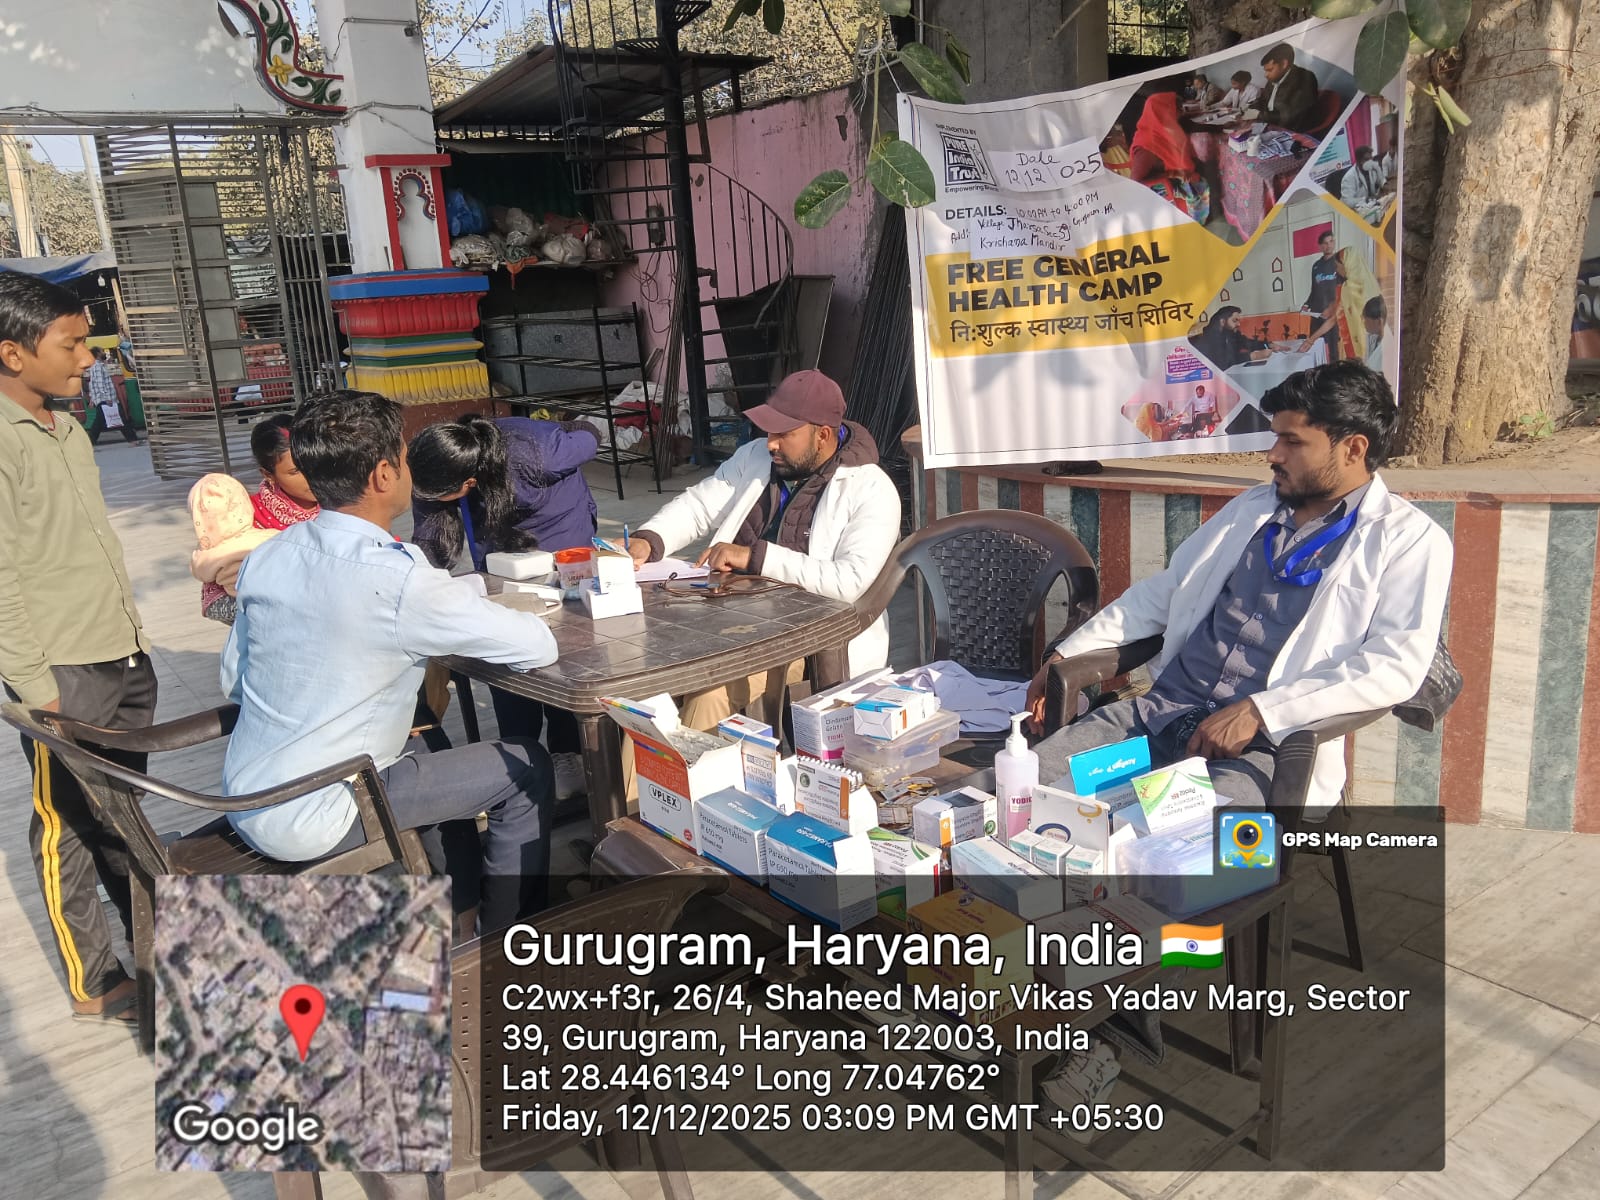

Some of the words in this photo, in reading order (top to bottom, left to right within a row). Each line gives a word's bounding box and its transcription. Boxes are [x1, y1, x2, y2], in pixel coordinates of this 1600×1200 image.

[948, 151, 976, 167] India
[945, 205, 1007, 220] DETAILS:
[948, 258, 1024, 286] FREE
[1033, 241, 1171, 278] GENERAL
[948, 282, 1069, 313] HEALTH
[1079, 271, 1163, 302] CAMP
[1027, 315, 1088, 338] स्वास्थ्य
[1095, 305, 1134, 332] जाँच
[1136, 299, 1194, 329] शिविर
[652, 787, 678, 808] VPLEX
